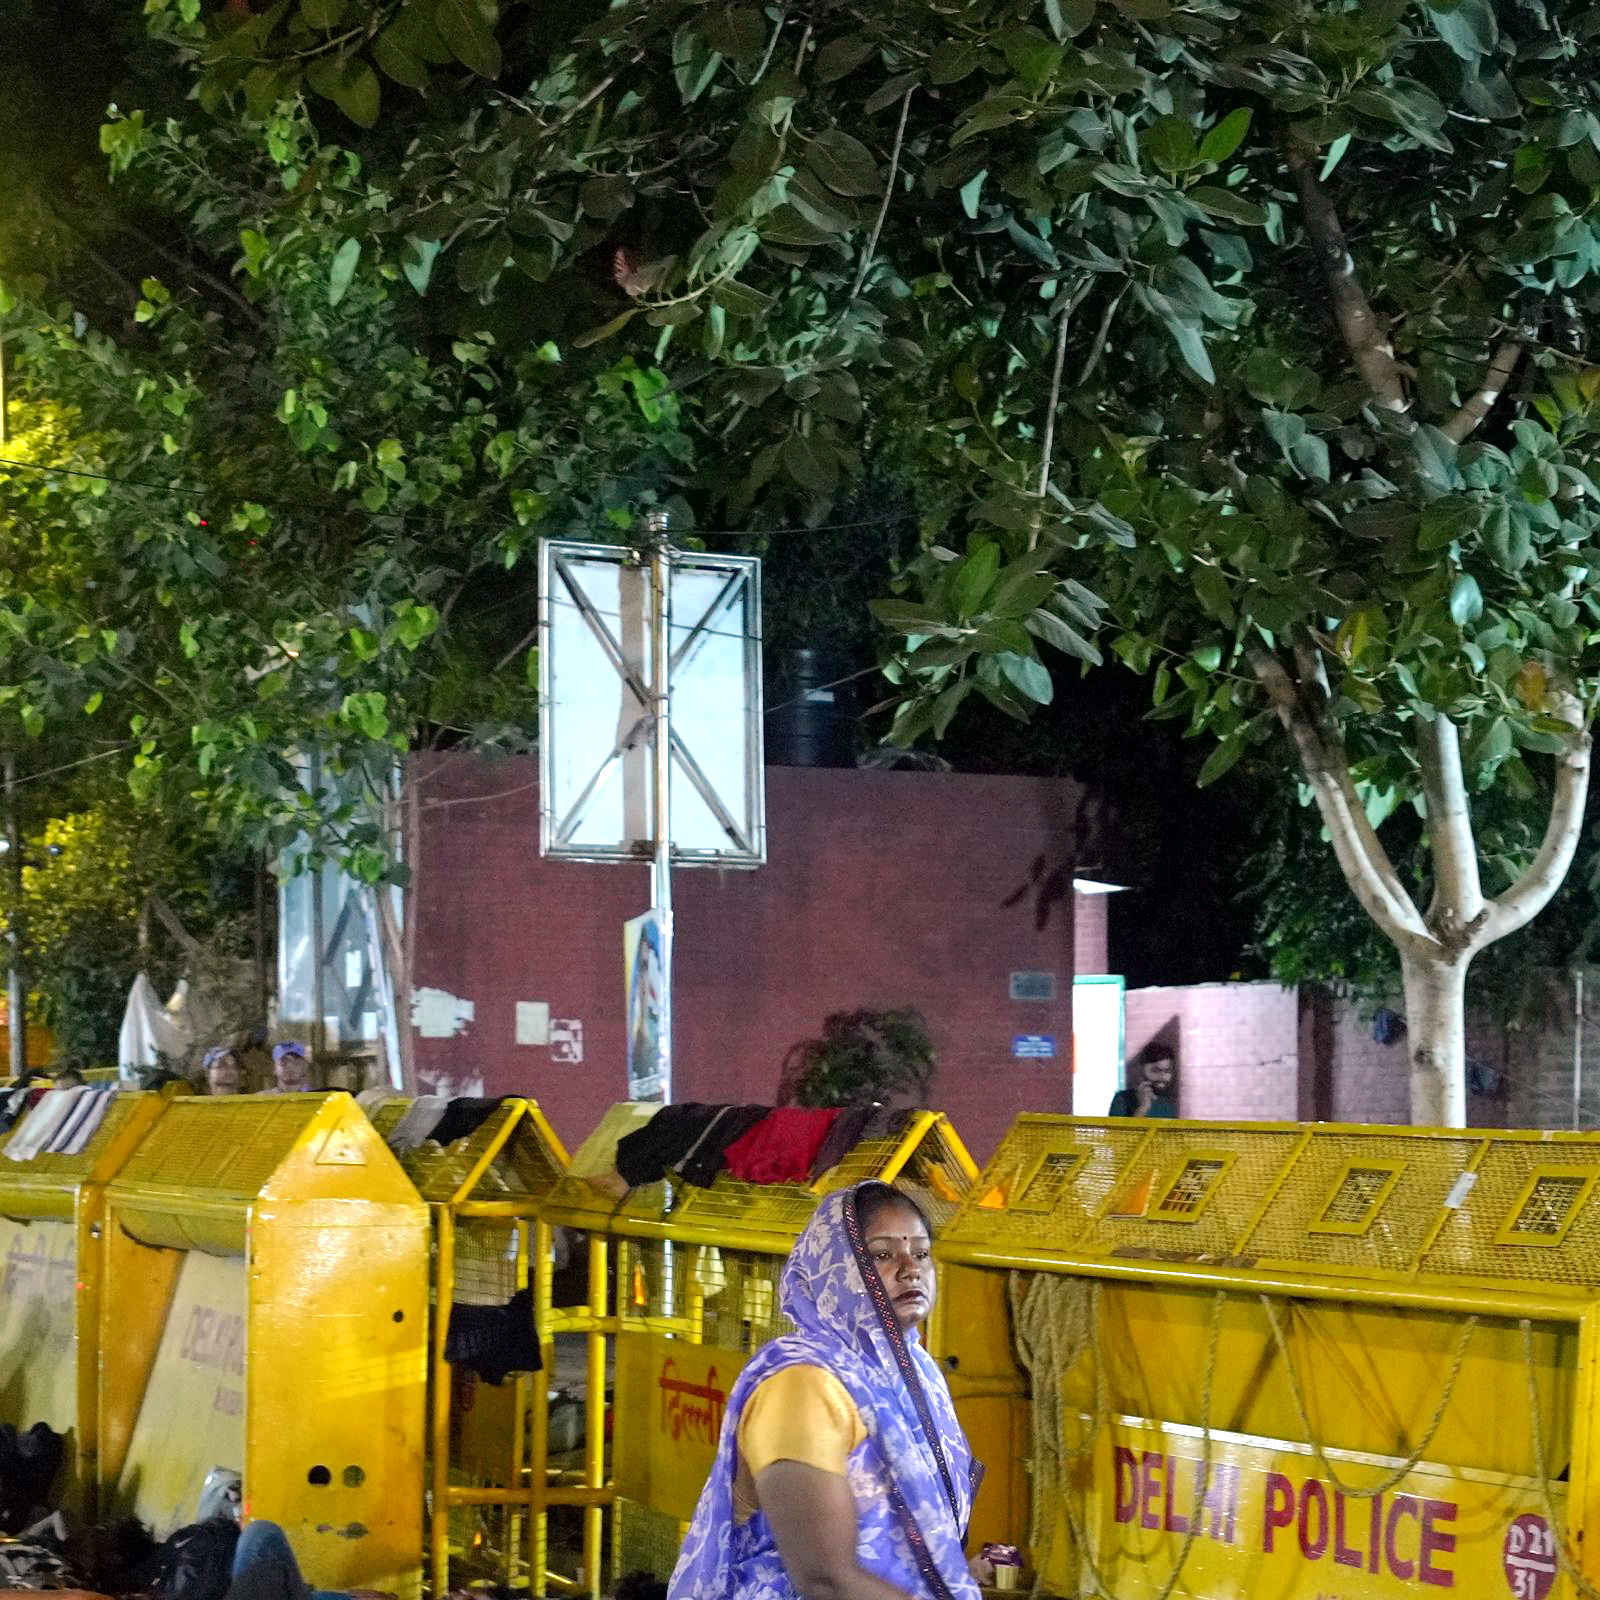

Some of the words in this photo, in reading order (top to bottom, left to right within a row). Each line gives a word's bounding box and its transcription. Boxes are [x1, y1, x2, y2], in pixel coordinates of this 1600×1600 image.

[1114, 1446, 1238, 1544] DELHI
[1263, 1472, 1458, 1588] POLICE
[1508, 1523, 1555, 1556] D21
[1511, 1568, 1536, 1600] 31
